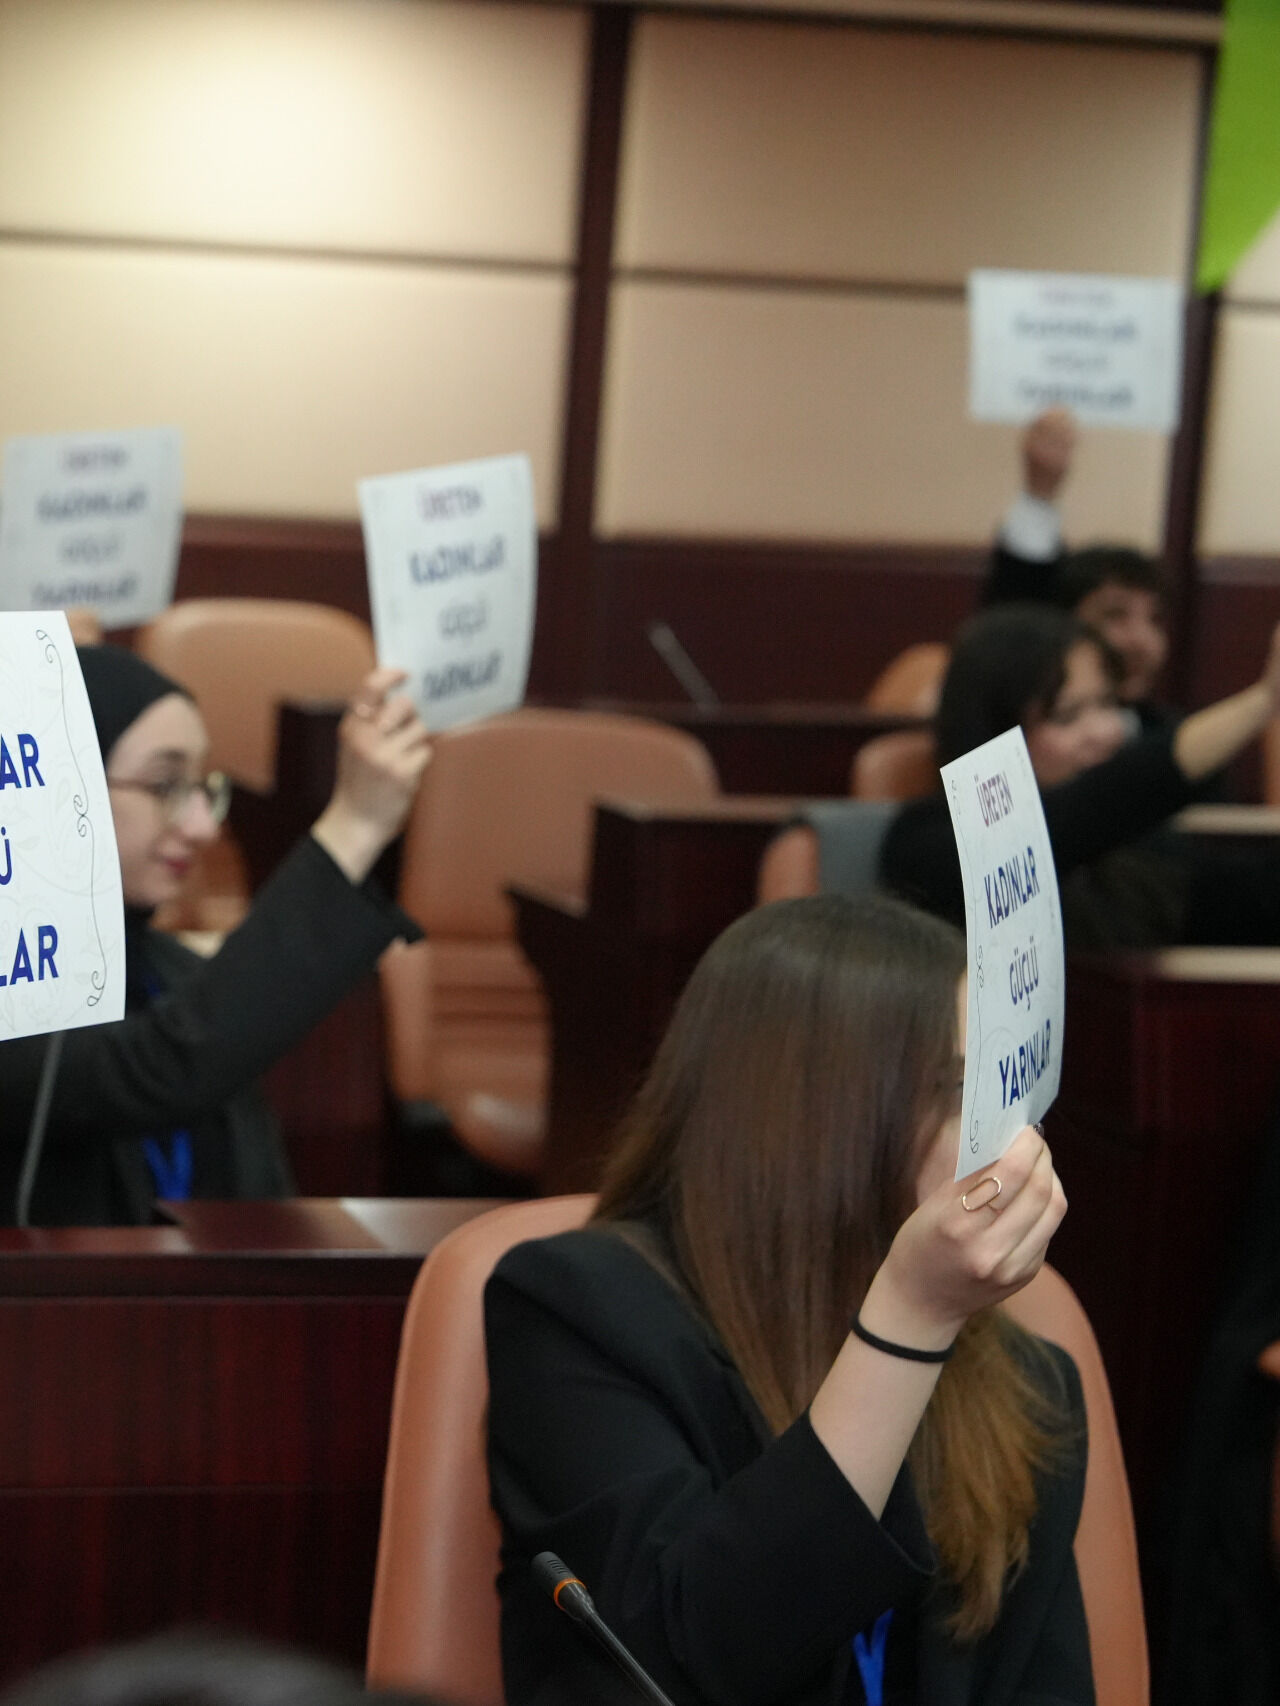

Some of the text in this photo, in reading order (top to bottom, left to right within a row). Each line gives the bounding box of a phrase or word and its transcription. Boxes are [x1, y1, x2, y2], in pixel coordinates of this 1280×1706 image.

[974, 771, 1014, 828] ÜRETEN
[984, 846, 1040, 929] KADINLAR
[1010, 936, 1039, 1011] GÜÇLÜ
[999, 1019, 1051, 1109] YARINLAR
